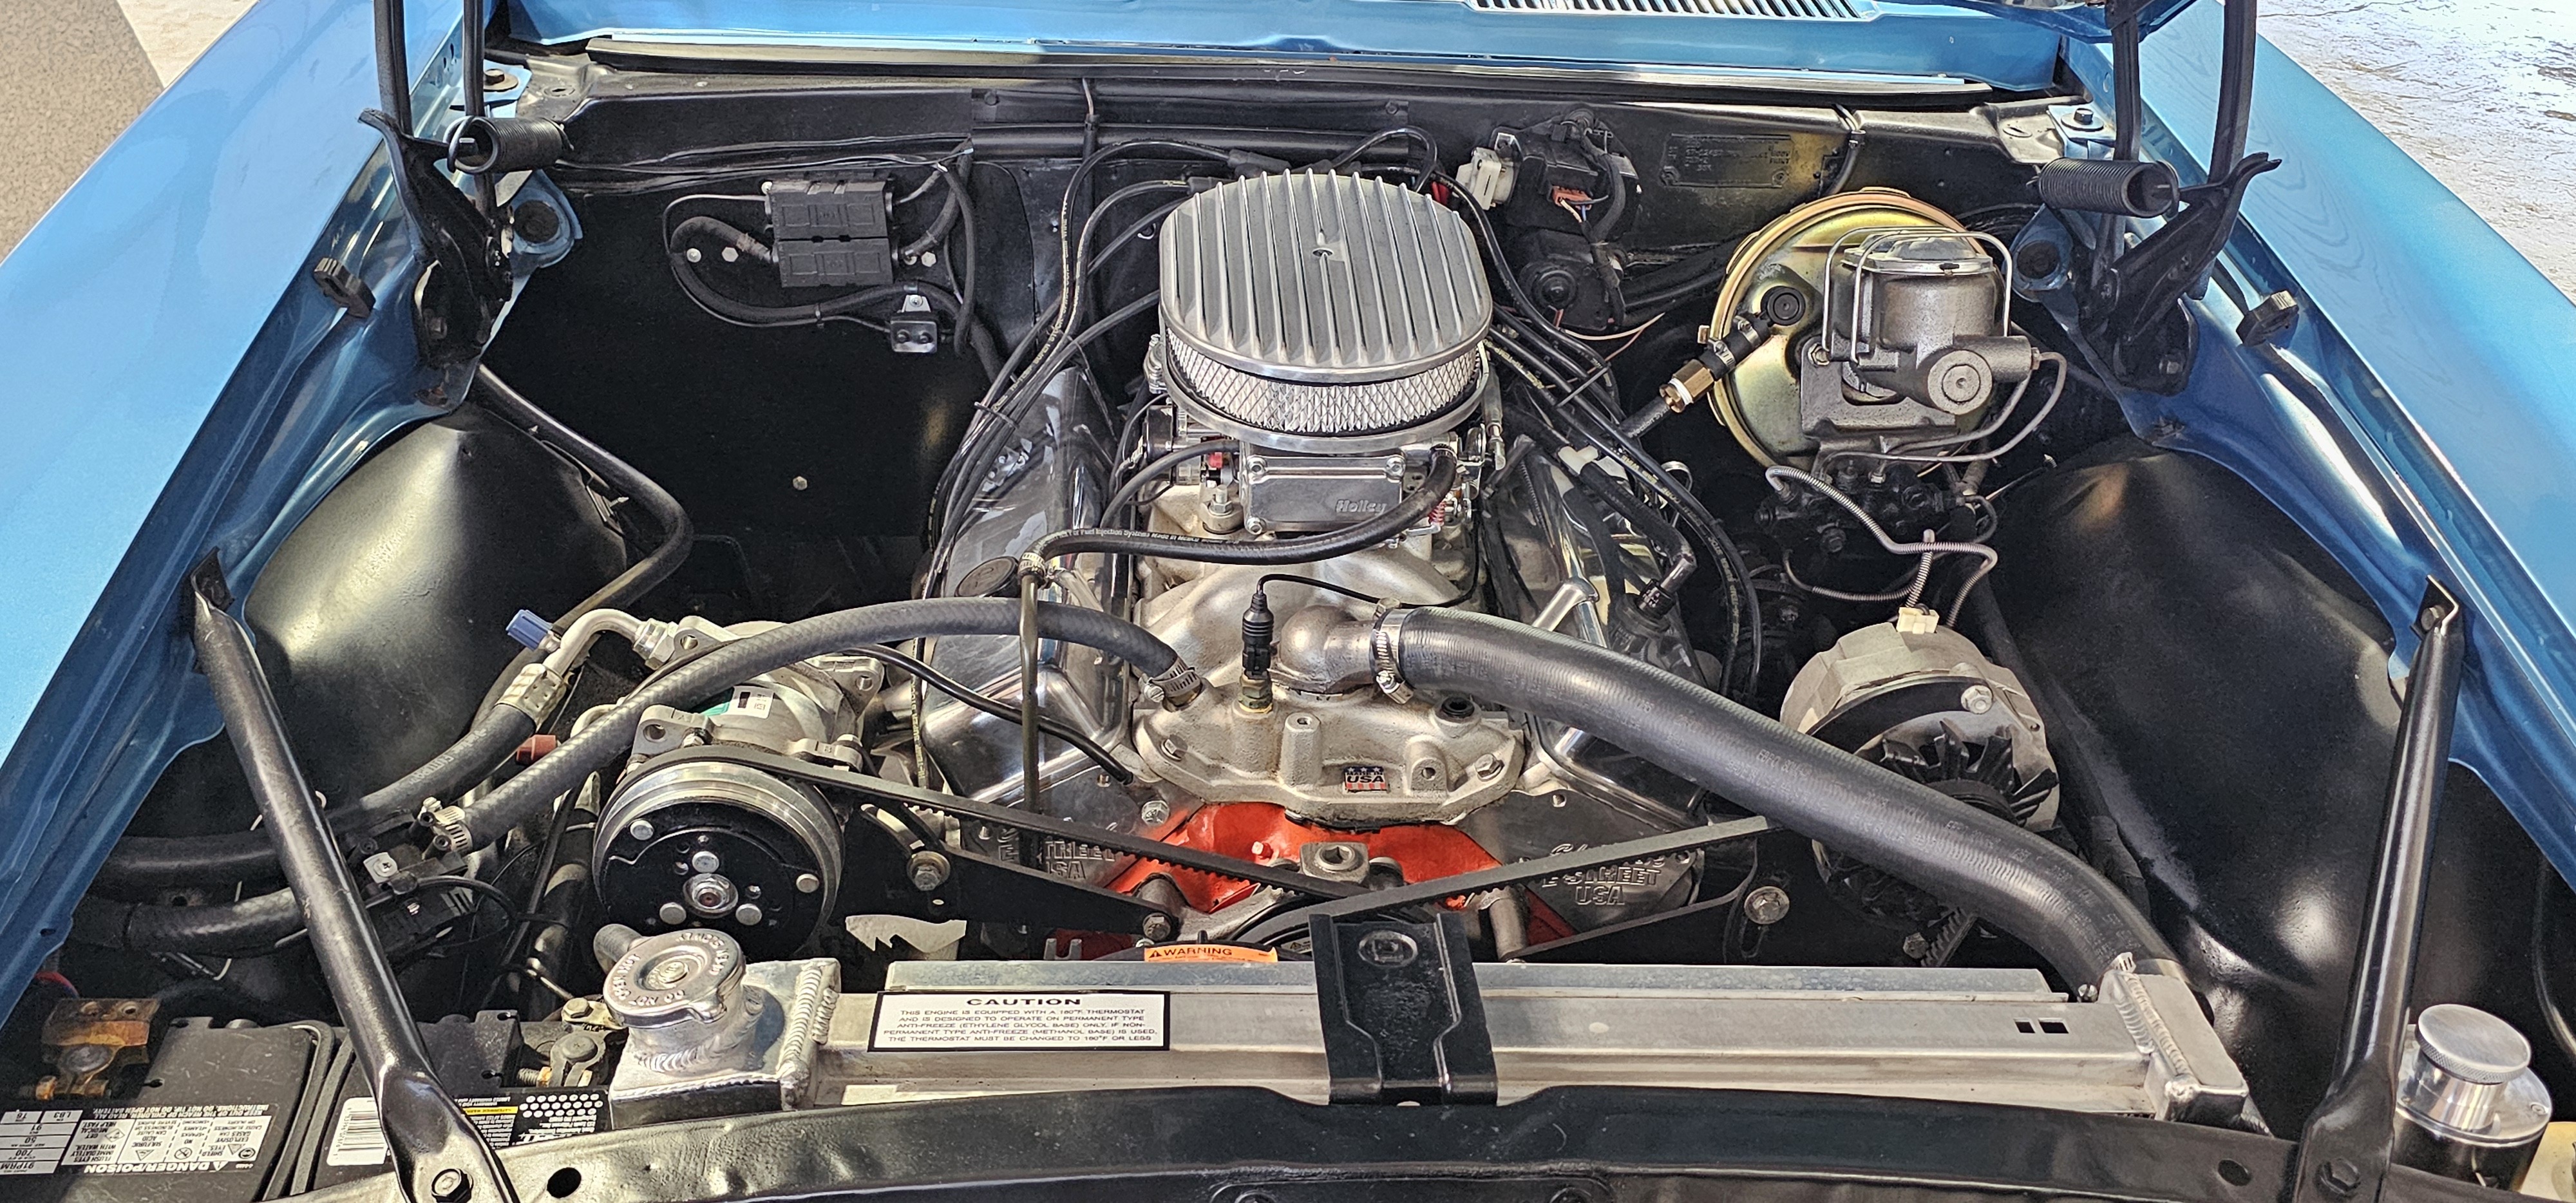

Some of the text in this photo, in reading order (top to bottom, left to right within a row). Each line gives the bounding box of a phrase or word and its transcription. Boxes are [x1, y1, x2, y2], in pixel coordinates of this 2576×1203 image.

[1335, 499, 1387, 516] Holley
[1575, 886, 1625, 905] USA
[1164, 948, 1233, 956] WARNING
[84, 1162, 210, 1173] DANGER/POISON
